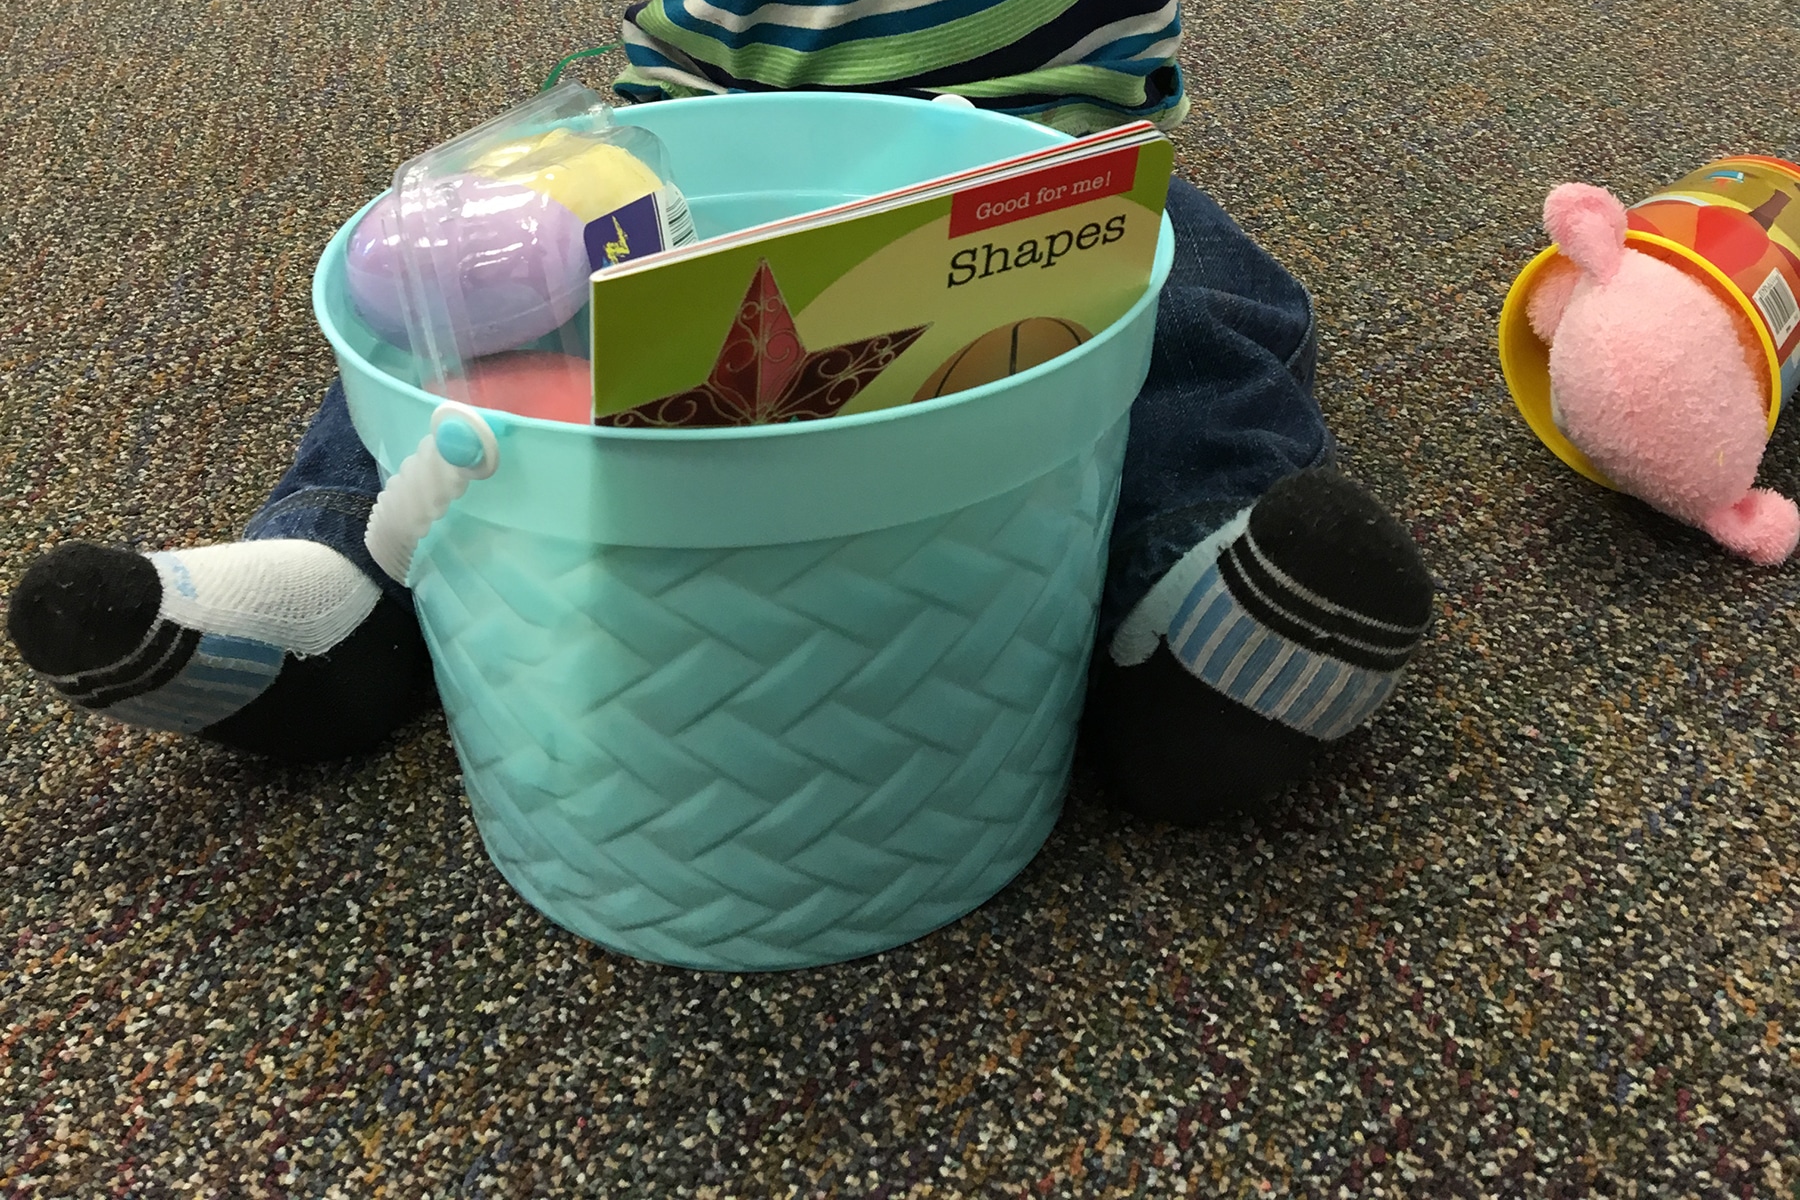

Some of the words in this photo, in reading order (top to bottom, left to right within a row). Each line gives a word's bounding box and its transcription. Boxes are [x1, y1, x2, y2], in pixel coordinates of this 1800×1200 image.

[975, 192, 1030, 221] Good
[1035, 184, 1068, 205] for
[1071, 170, 1113, 196] me!
[947, 214, 1127, 289] Shapes
